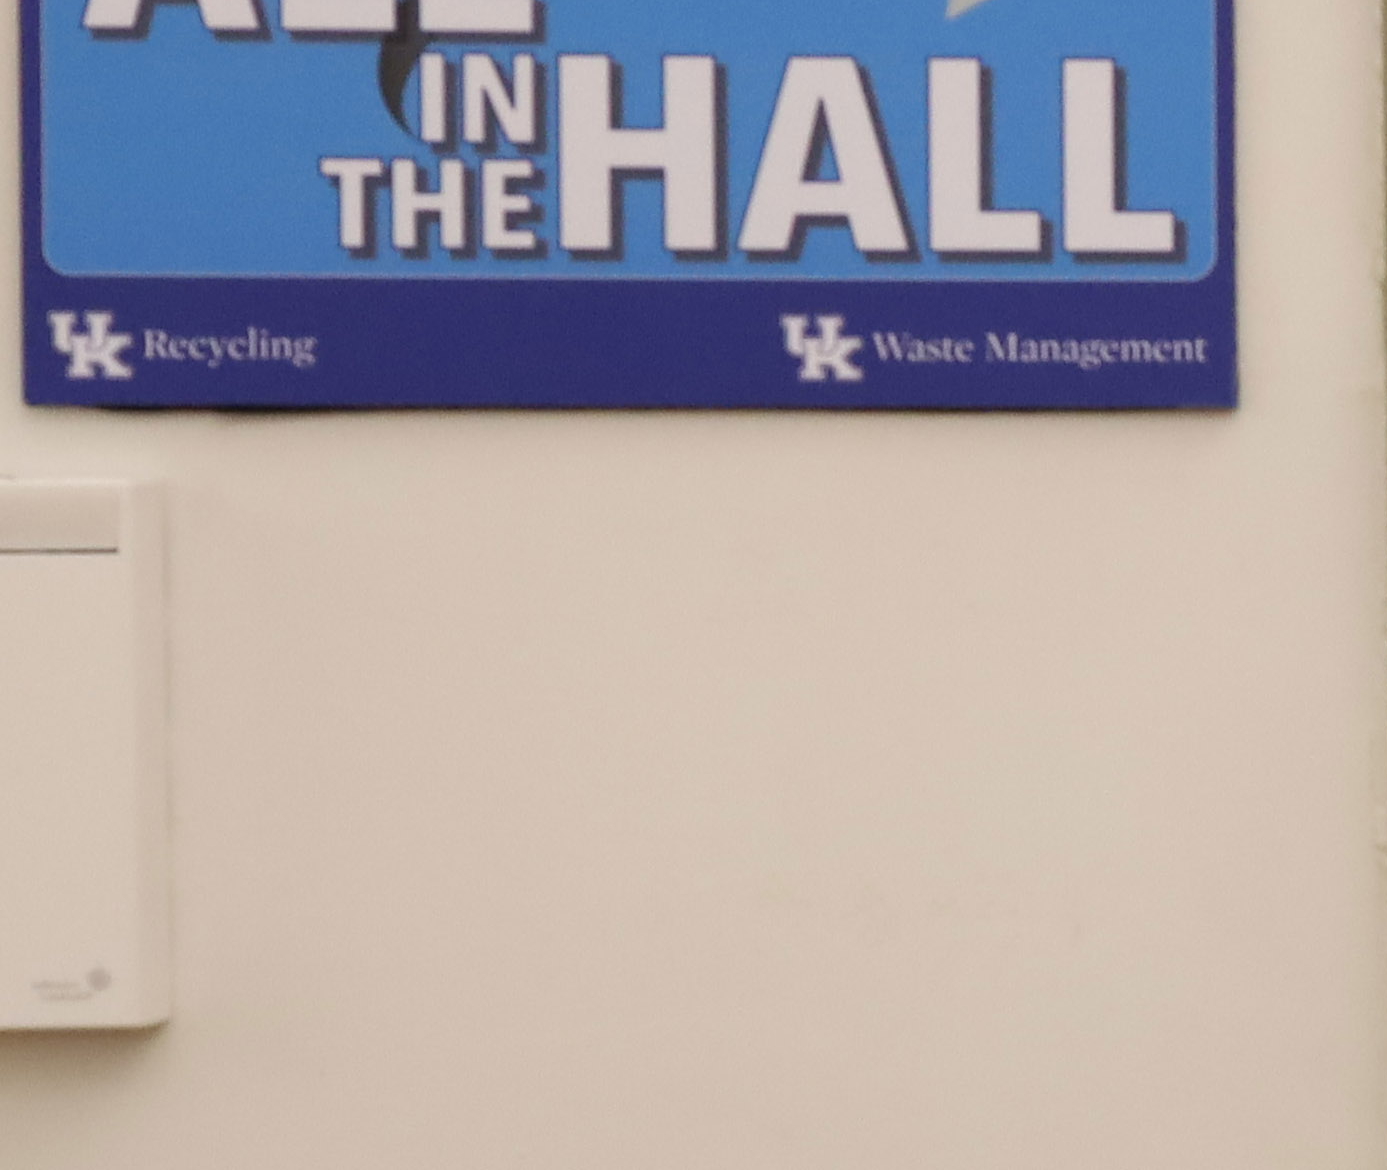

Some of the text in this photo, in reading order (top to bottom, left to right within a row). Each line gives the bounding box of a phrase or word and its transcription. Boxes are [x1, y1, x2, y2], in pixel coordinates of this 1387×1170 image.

[418, 52, 539, 147] IN
[558, 53, 1178, 254] HALL
[319, 157, 539, 253] THE
[47, 311, 318, 380] UK Recycling
[780, 313, 1208, 382] UK Waste Management
